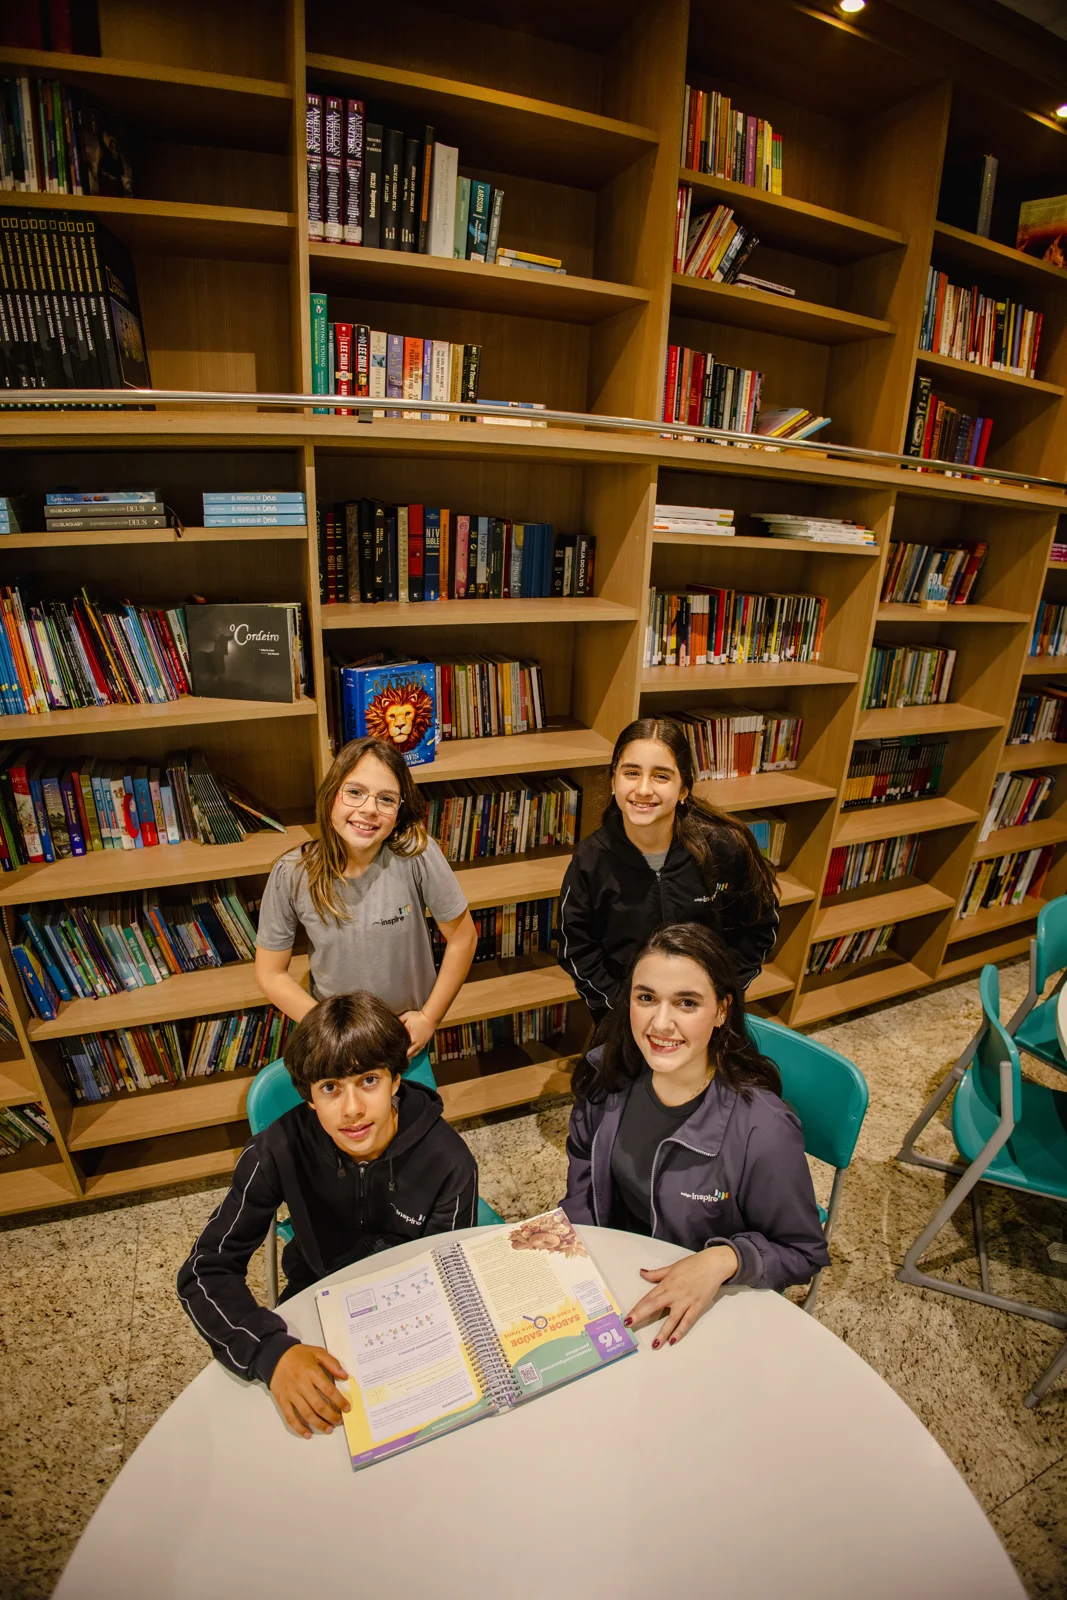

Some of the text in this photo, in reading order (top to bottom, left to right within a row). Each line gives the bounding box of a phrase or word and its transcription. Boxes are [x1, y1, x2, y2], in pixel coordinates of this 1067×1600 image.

[313, 108, 321, 154] AMERICAN
[326, 114, 334, 153] WRITERS
[333, 111, 341, 157] AMERICAN
[347, 116, 355, 154] WRITERS
[354, 114, 363, 159] AMERICAN
[476, 185, 484, 213] LARSSON
[340, 341, 348, 370] LEE CHILD
[358, 344, 367, 372] LEE CHILD
[426, 528, 440, 538] NIV
[480, 533, 488, 547] holy
[234, 623, 280, 646] Cordeiro
[373, 674, 427, 693] NARNIA
[381, 916, 404, 926] inspire
[692, 1192, 718, 1202] inspire
[396, 1209, 422, 1226] inspire
[557, 1308, 571, 1317] caso
[549, 1314, 581, 1332] SABOR
[504, 1330, 520, 1339] trans
[510, 1330, 543, 1347] SAÚDE
[598, 1327, 623, 1347] 16
